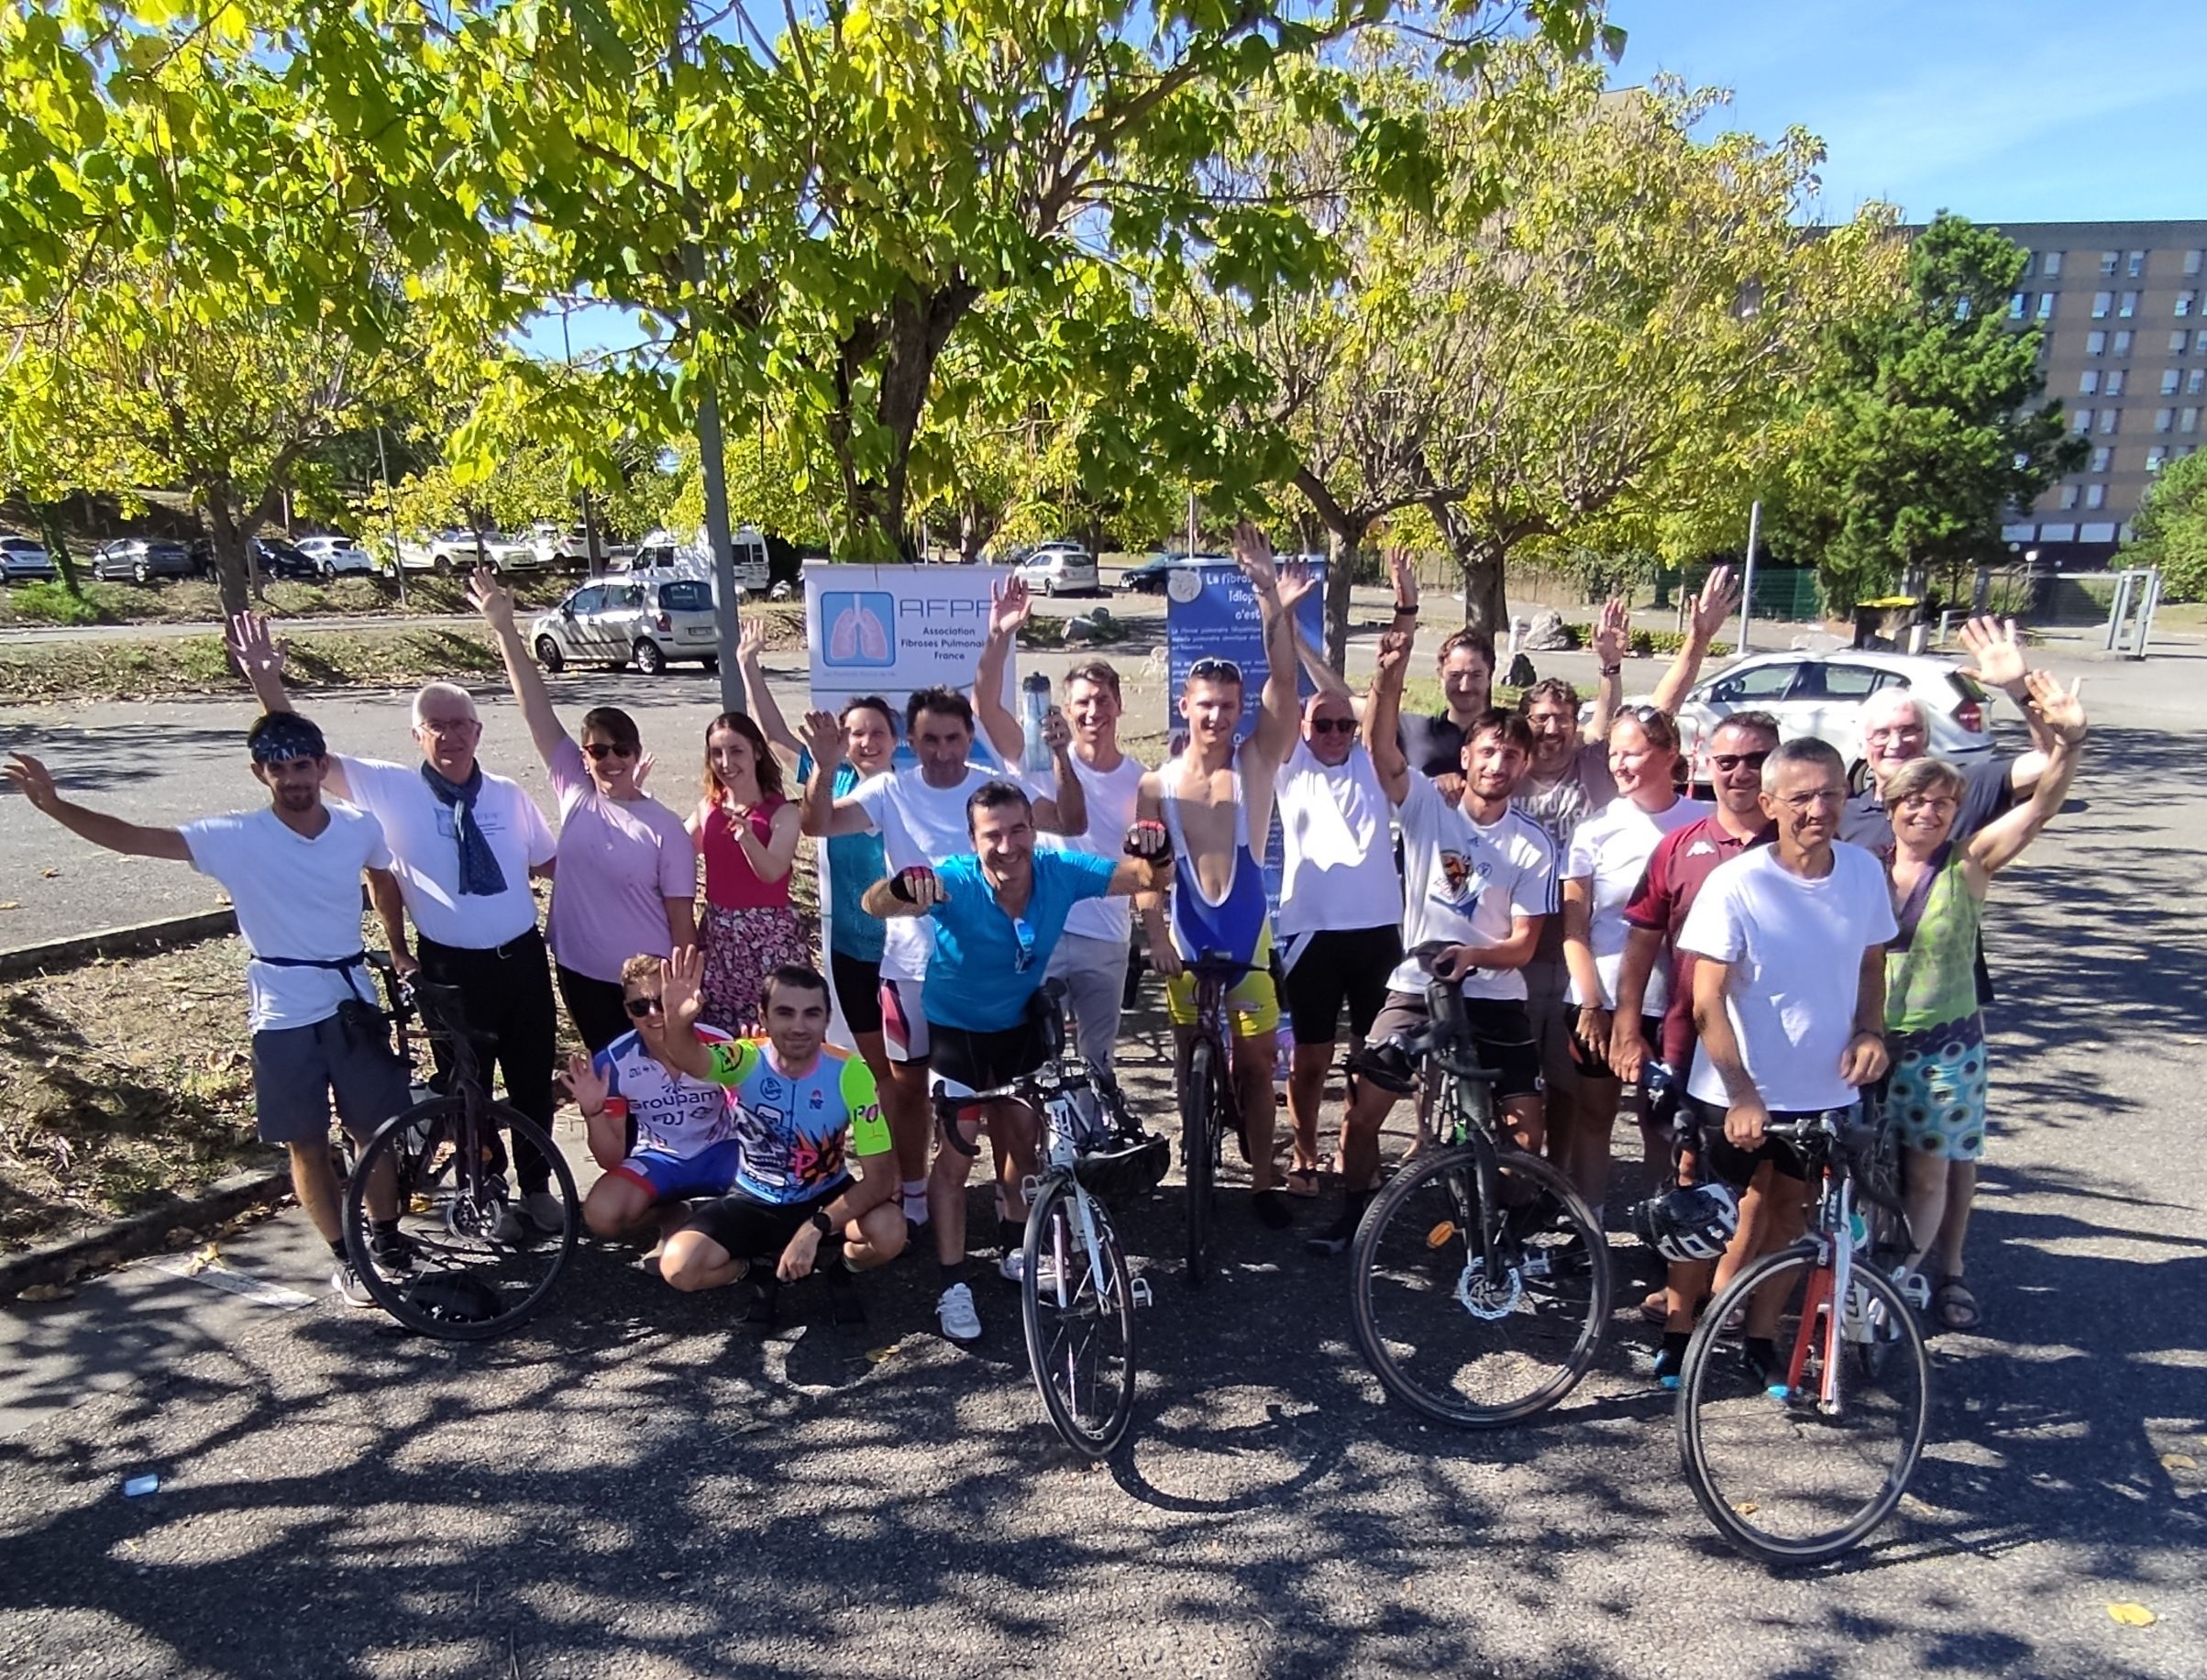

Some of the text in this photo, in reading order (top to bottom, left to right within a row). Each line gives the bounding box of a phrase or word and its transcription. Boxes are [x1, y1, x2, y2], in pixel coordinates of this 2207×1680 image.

[1205, 572, 1219, 585] La
[922, 626, 976, 636] Association
[900, 638, 938, 648] Fibroses
[933, 651, 966, 660] France
